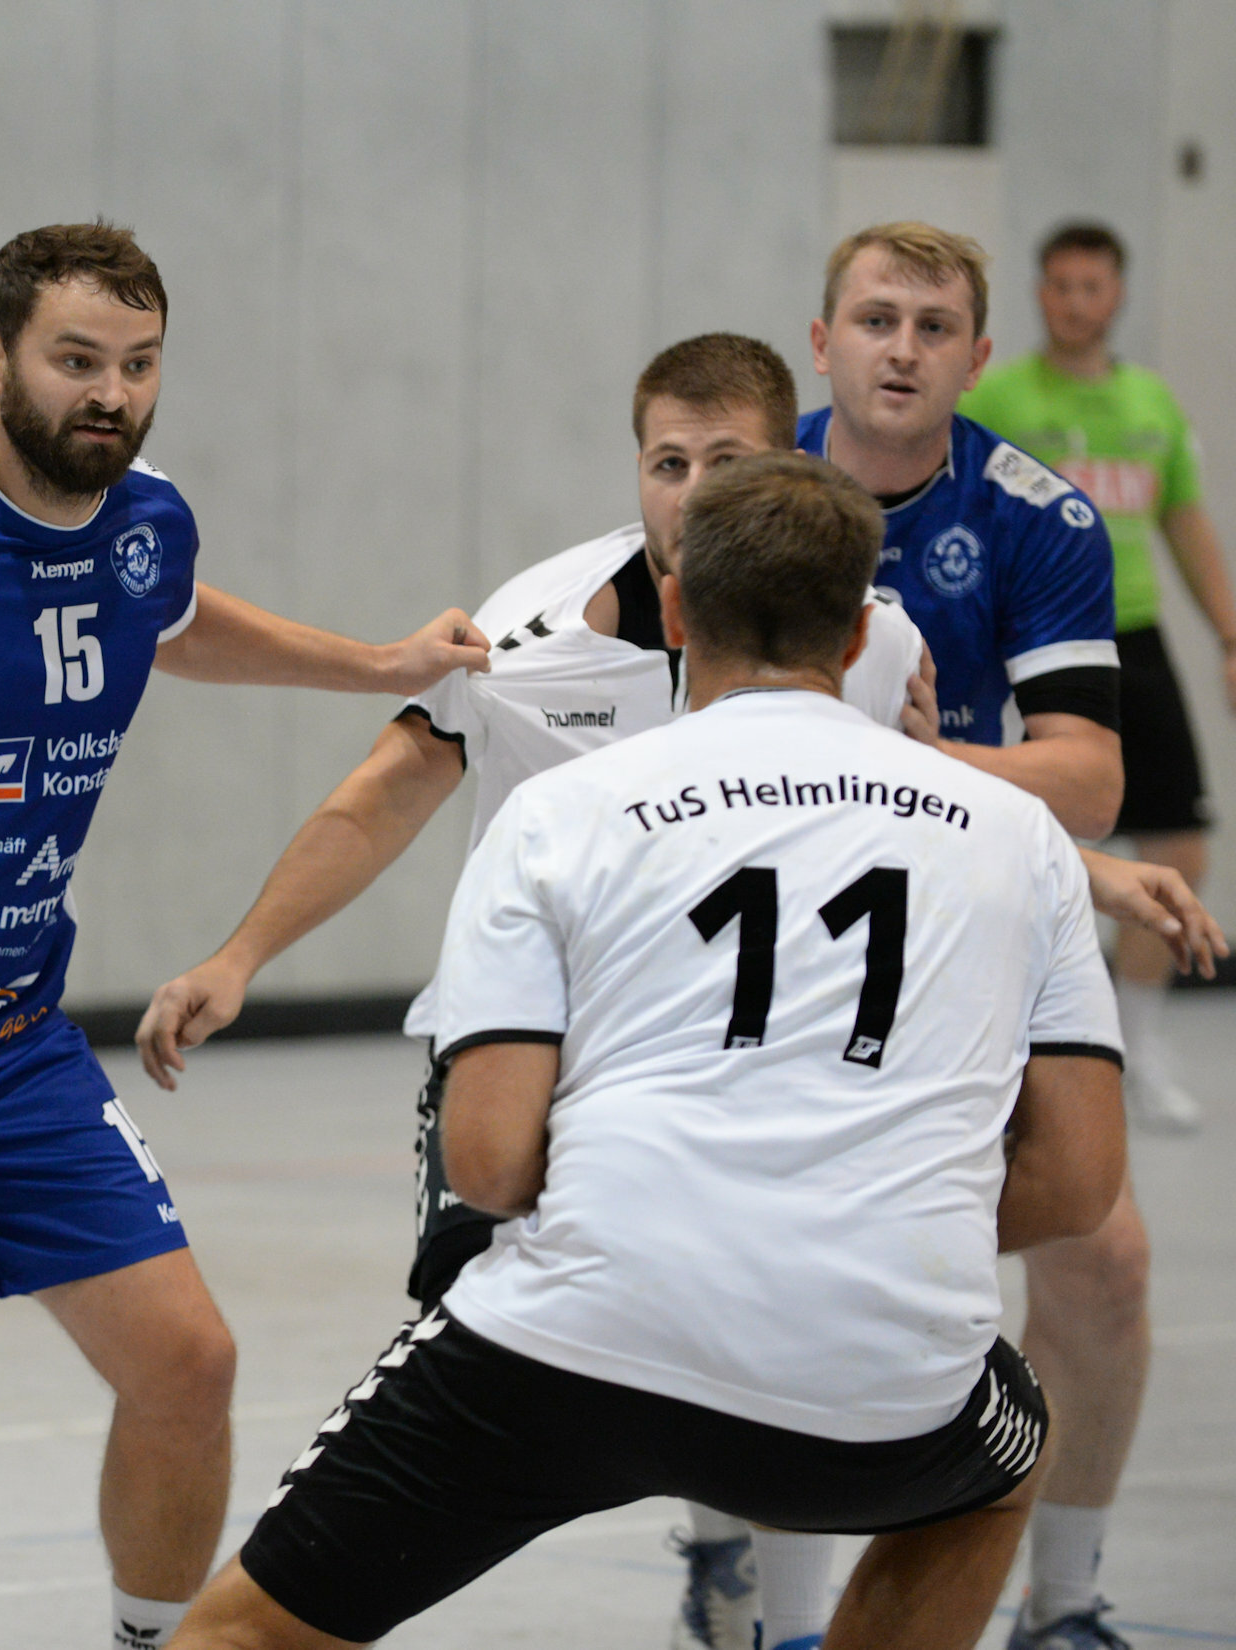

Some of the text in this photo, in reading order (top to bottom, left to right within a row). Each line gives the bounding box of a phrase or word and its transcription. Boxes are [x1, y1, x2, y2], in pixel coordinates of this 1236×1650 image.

[31, 558, 95, 582] Kempa
[33, 602, 105, 705] 15
[541, 706, 616, 728] hummel
[624, 774, 972, 832] TuS Helmlingen
[687, 866, 909, 1070] 11
